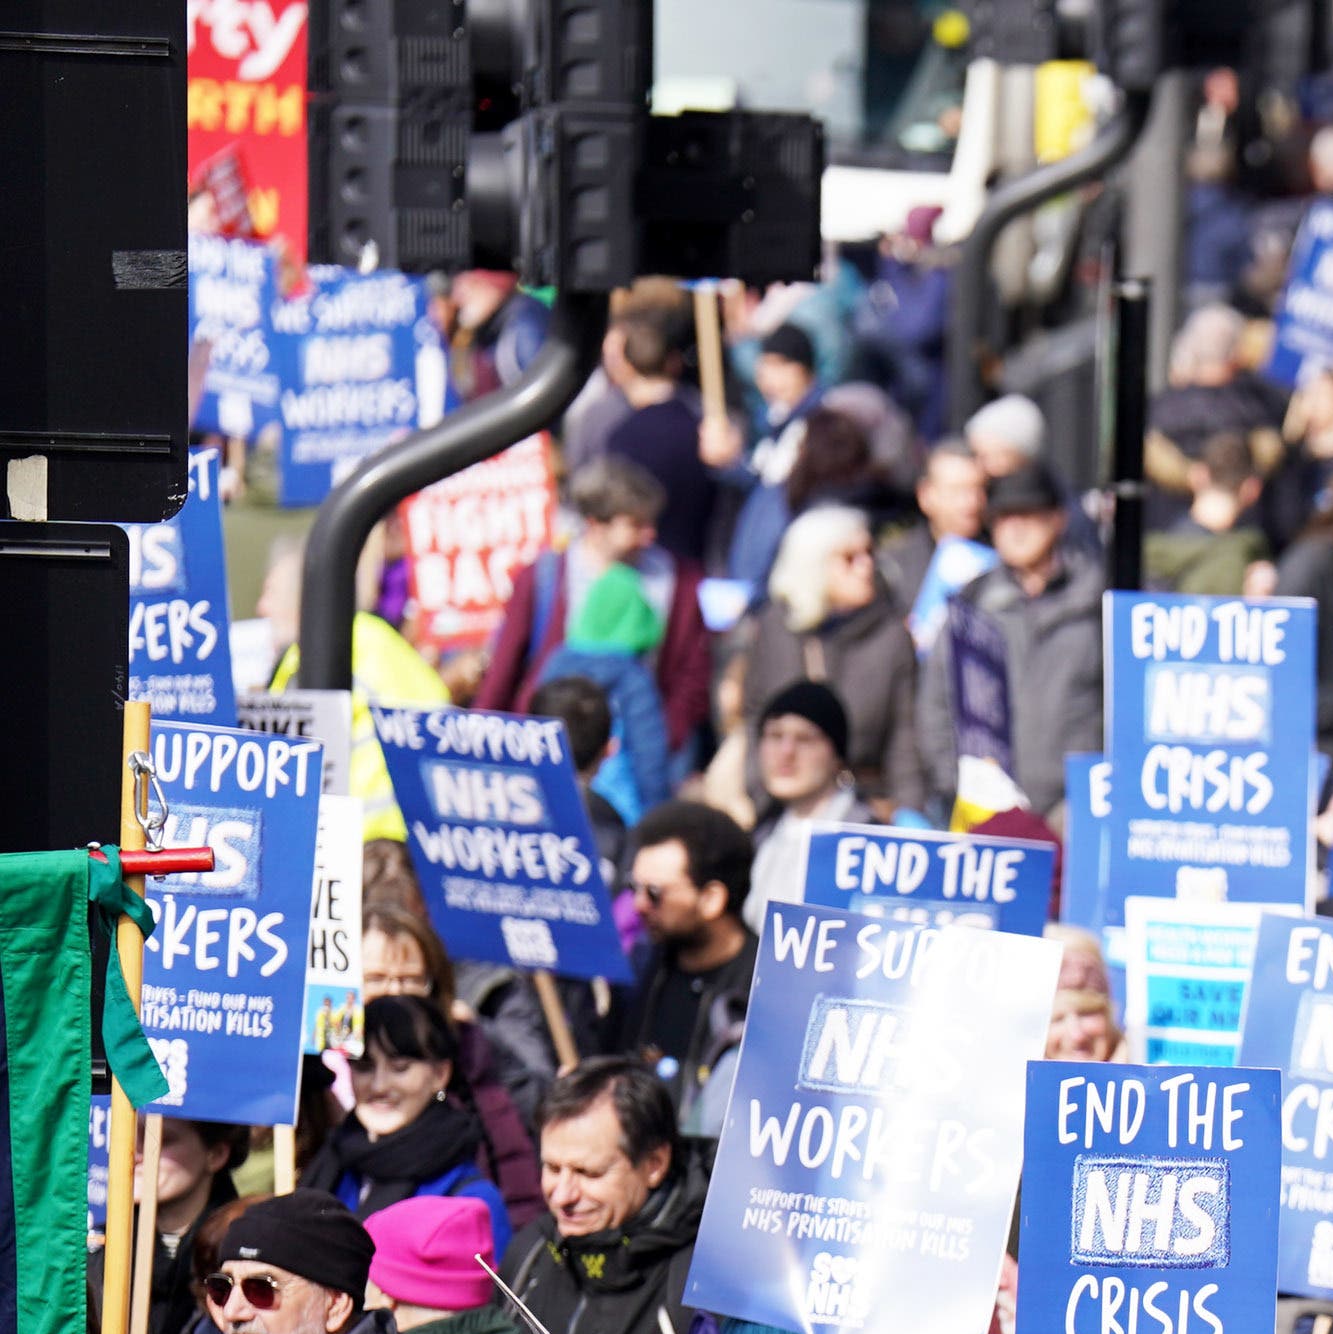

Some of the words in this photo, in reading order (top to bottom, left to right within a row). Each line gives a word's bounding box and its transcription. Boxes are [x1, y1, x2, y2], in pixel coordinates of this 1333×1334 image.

[1131, 602, 1207, 661] END
[1212, 600, 1290, 665] THE
[370, 708, 425, 750] WE
[427, 711, 564, 766] SUPPORT
[1149, 668, 1269, 741] NHS
[154, 732, 322, 798] UPPORT
[431, 764, 544, 826] NHS
[1140, 745, 1274, 815] CRISIS
[413, 821, 592, 886] WORKERS
[834, 836, 930, 894] END
[937, 838, 1026, 902] THE
[773, 911, 847, 973] WE
[226, 1008, 273, 1037] KILLS
[1057, 1076, 1147, 1150] END
[1160, 1072, 1251, 1152] THE
[742, 1207, 785, 1235] NHS
[750, 1187, 801, 1210] SUPPORT
[803, 1193, 826, 1213] THE
[1079, 1169, 1220, 1257] NHS
